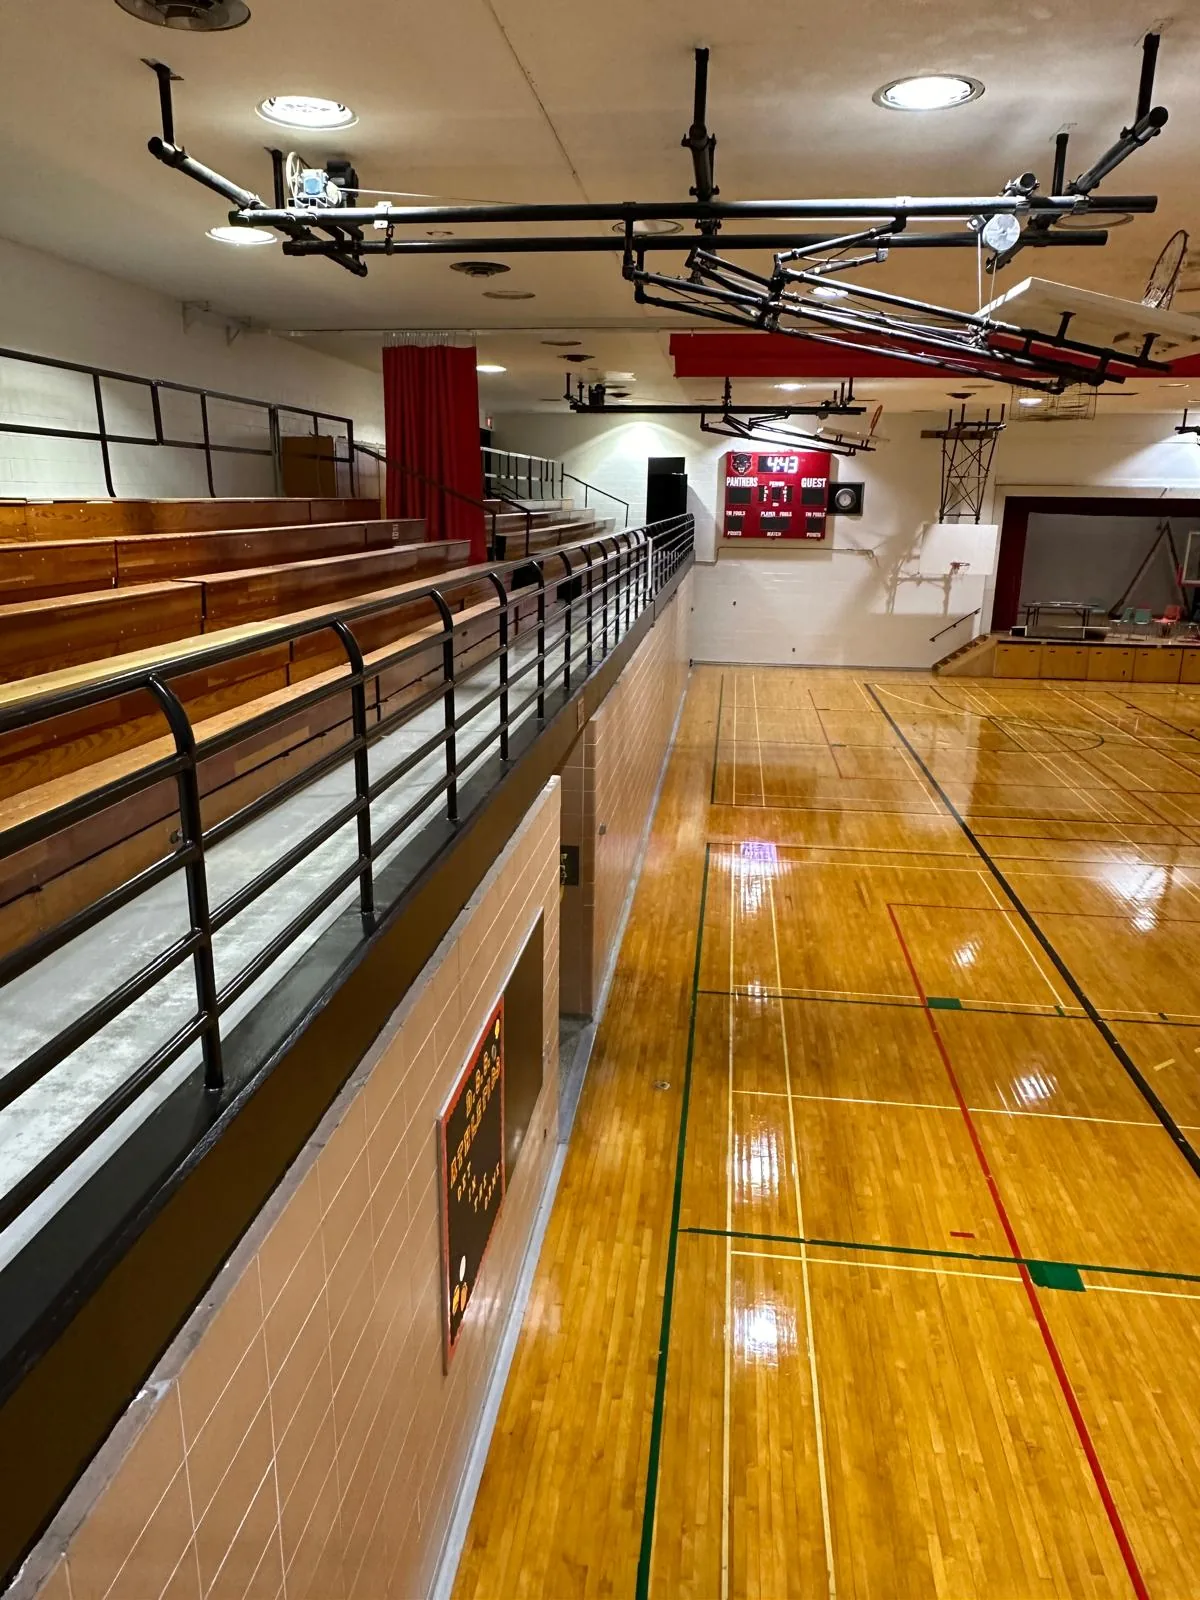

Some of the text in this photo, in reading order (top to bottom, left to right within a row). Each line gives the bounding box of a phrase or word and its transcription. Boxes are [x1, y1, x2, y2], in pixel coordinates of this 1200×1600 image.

[767, 456, 798, 474] 4:43
[726, 476, 758, 487] PANTHERS
[801, 477, 827, 488] GUEST
